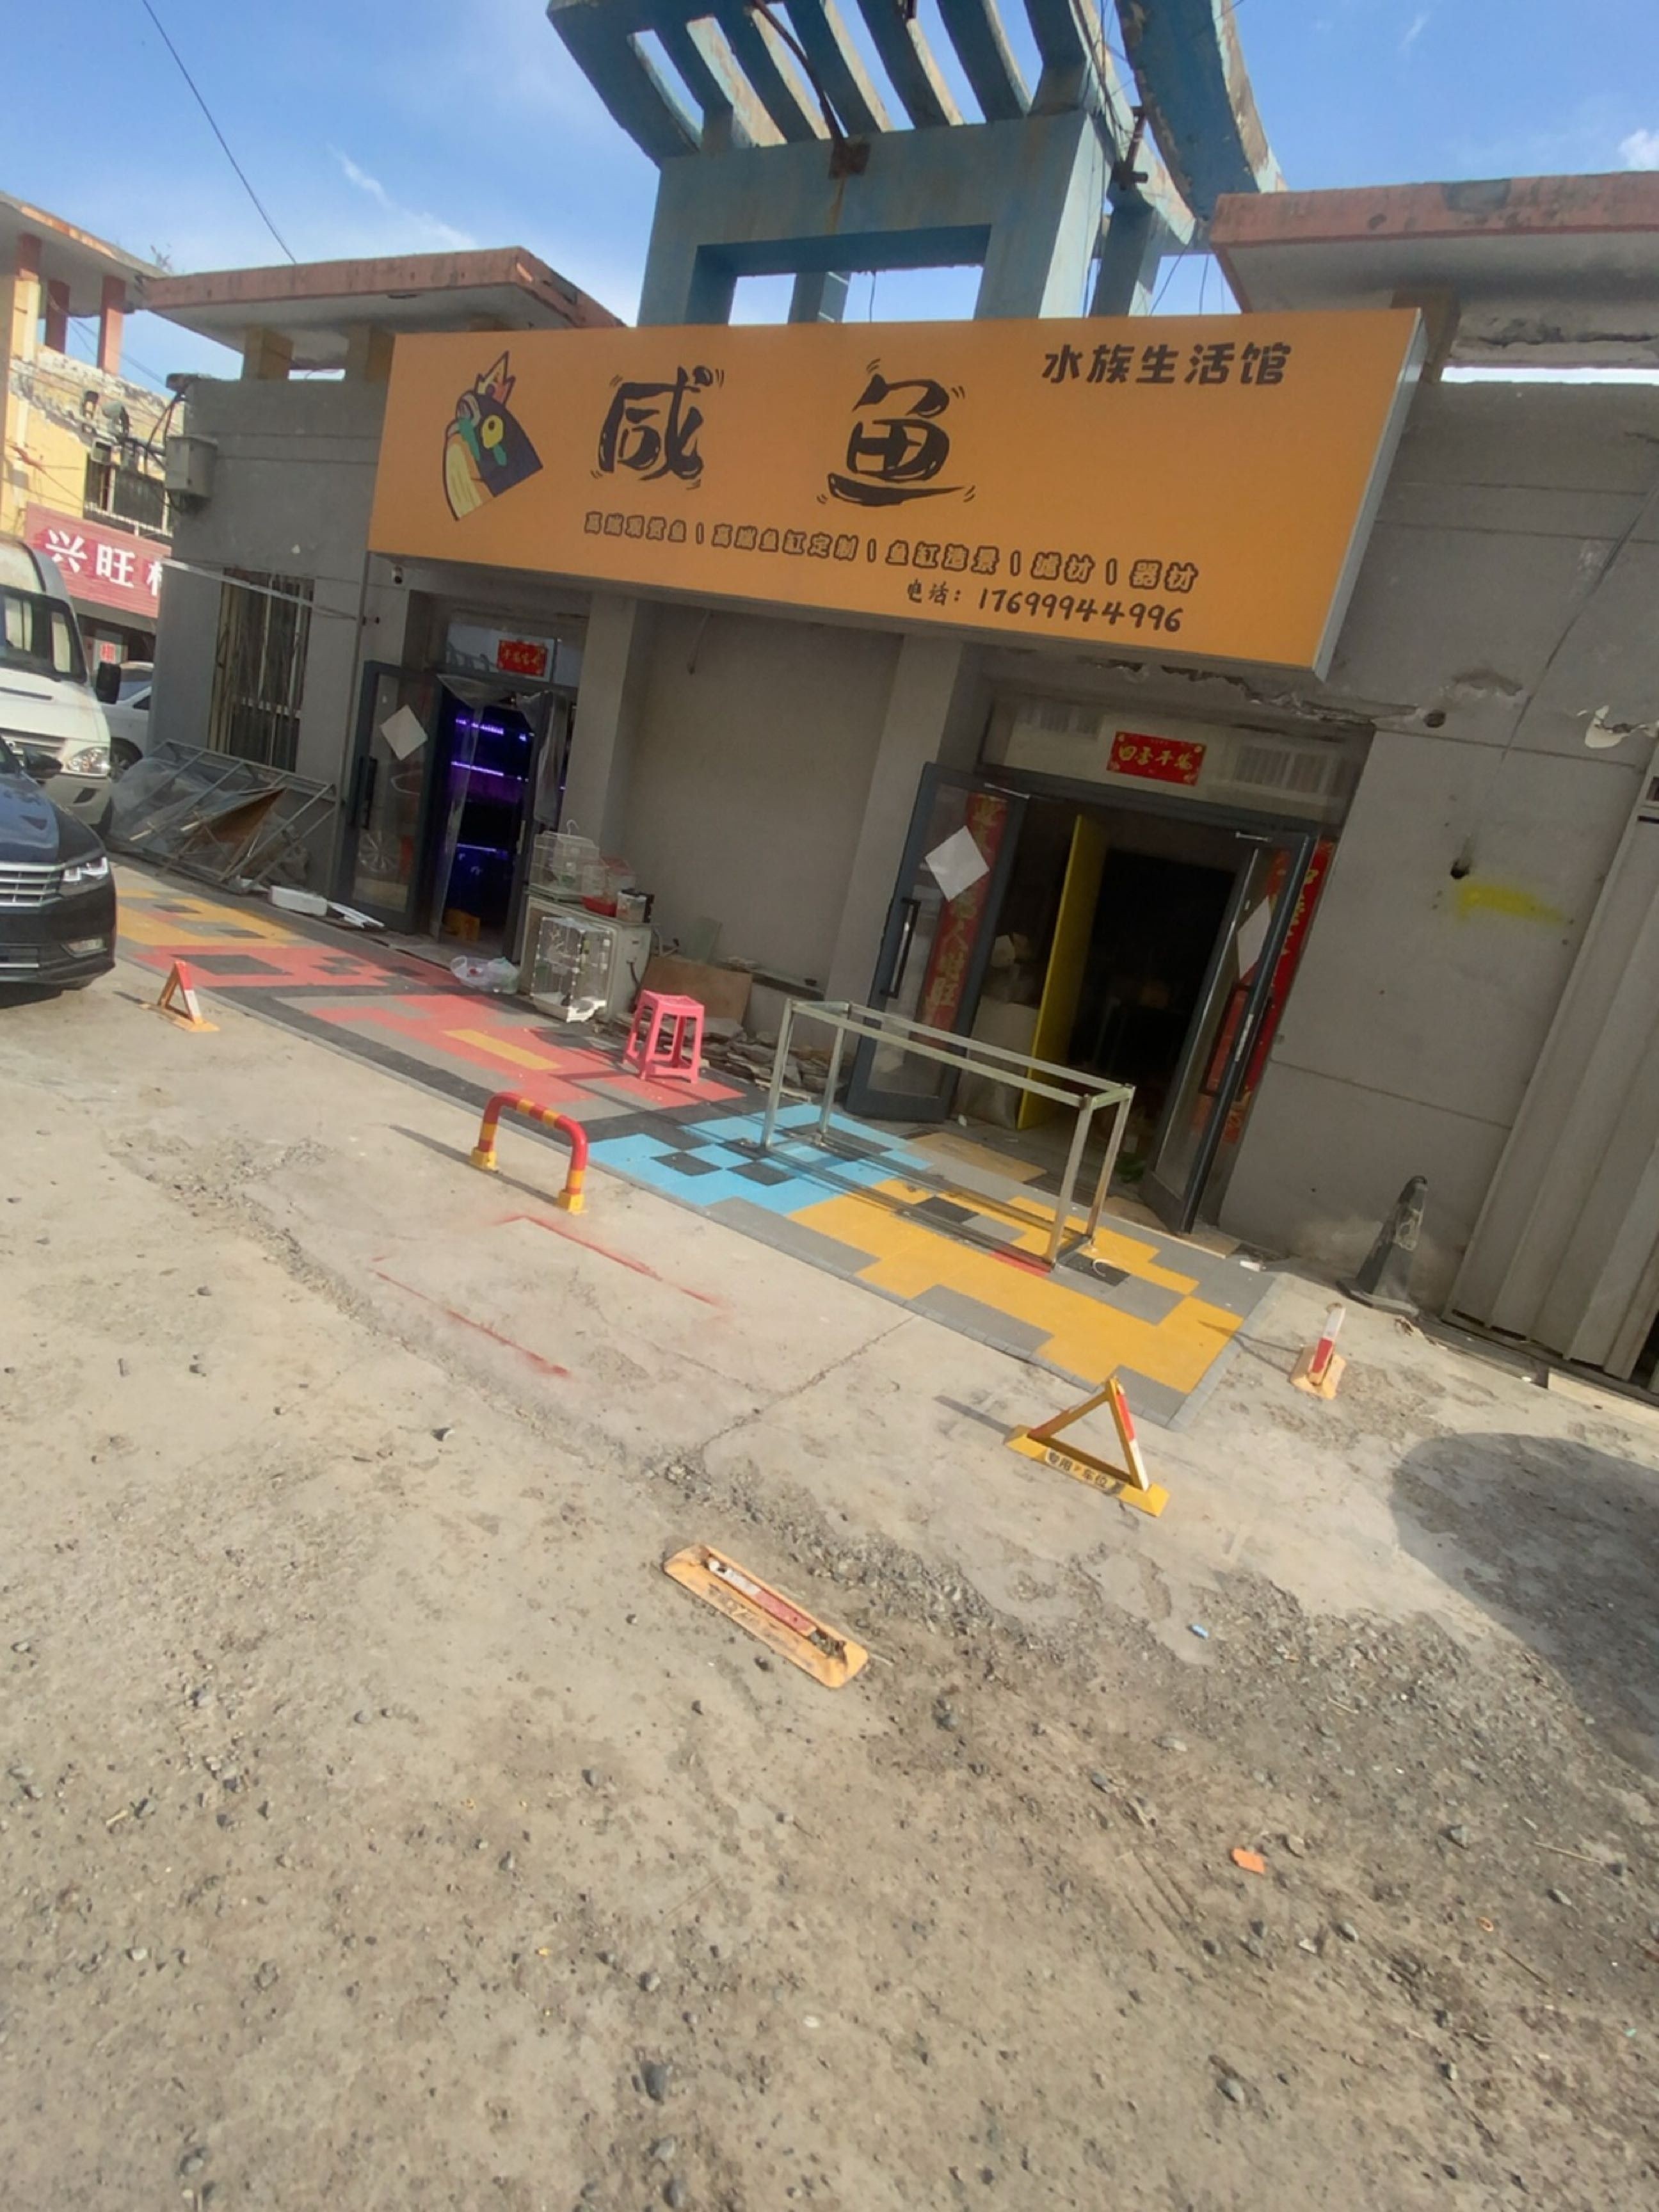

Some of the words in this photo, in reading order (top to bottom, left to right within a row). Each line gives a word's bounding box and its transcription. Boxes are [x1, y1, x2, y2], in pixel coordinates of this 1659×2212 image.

[1041, 341, 1292, 385] 水族生活馆
[597, 365, 965, 507] 咸鱼
[979, 588, 1184, 632] 17699944996
